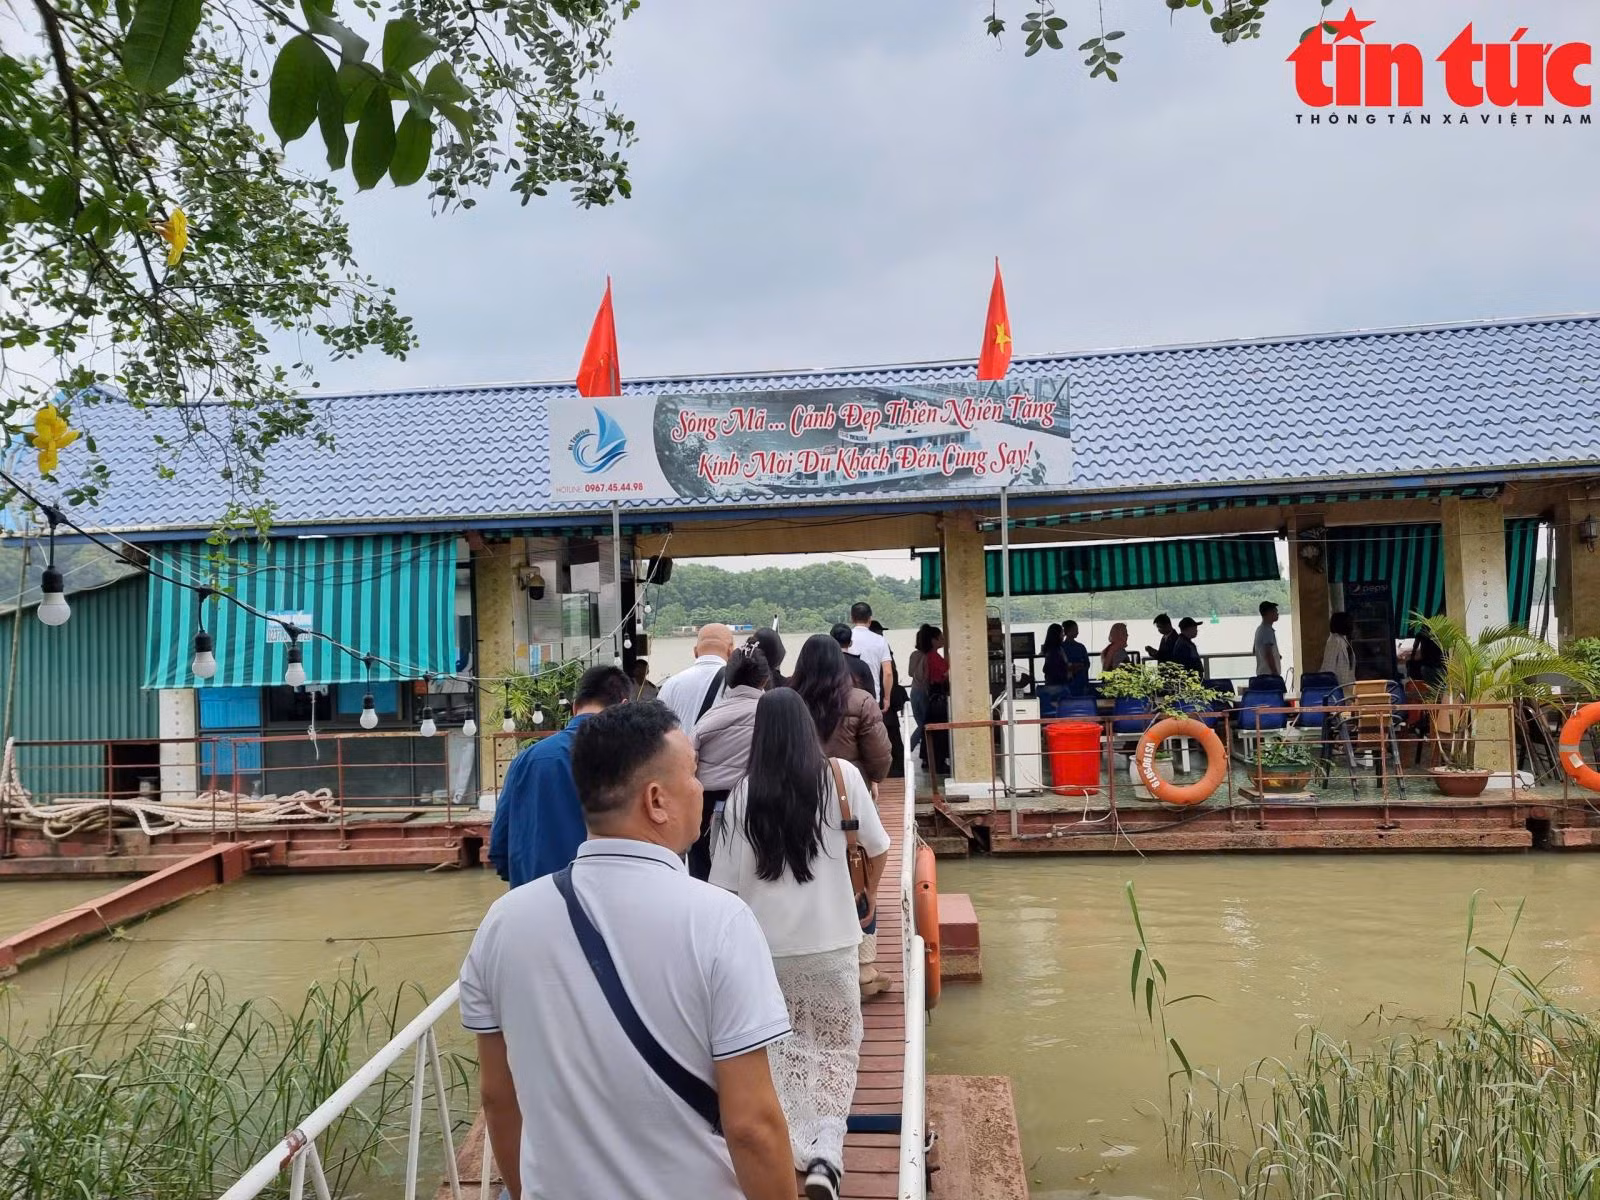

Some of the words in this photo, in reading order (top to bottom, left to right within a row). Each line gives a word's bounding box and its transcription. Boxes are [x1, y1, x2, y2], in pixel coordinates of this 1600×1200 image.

[671, 411, 718, 441] Sông
[791, 404, 836, 436] Cảnh
[839, 403, 881, 434] Đẹp
[886, 399, 938, 425] Thiên
[940, 398, 1003, 430] Nhiên
[699, 452, 740, 483] Kính
[743, 451, 794, 478] Mời
[797, 450, 831, 473] Du
[836, 447, 890, 479] Khách
[895, 444, 938, 469] Đến
[942, 445, 988, 474] Cùng
[990, 440, 1033, 473] Say!
